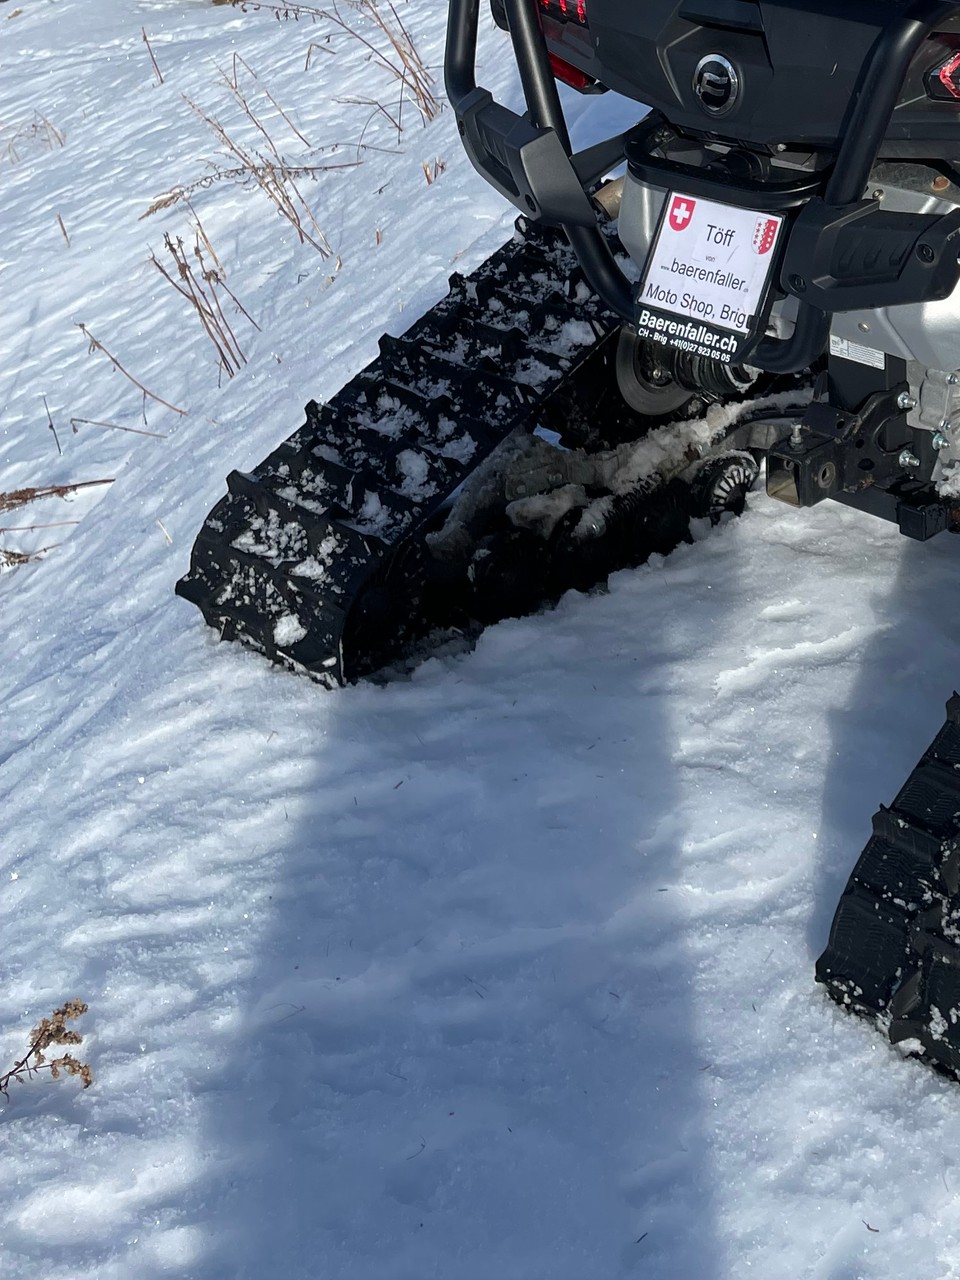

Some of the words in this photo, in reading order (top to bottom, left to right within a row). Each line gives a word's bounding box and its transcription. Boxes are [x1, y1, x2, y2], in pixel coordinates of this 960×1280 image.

[706, 224, 736, 247] Töff
[705, 255, 716, 263] von
[646, 283, 678, 305] Moto
[680, 293, 715, 319] Shop,
[720, 304, 747, 329] Brig
[638, 328, 650, 338] CH
[653, 332, 668, 345] Brig
[697, 346, 711, 357] 923
[711, 351, 721, 360] 05
[721, 354, 731, 363] 05
[639, 310, 738, 353] Baerenfaller.ch
